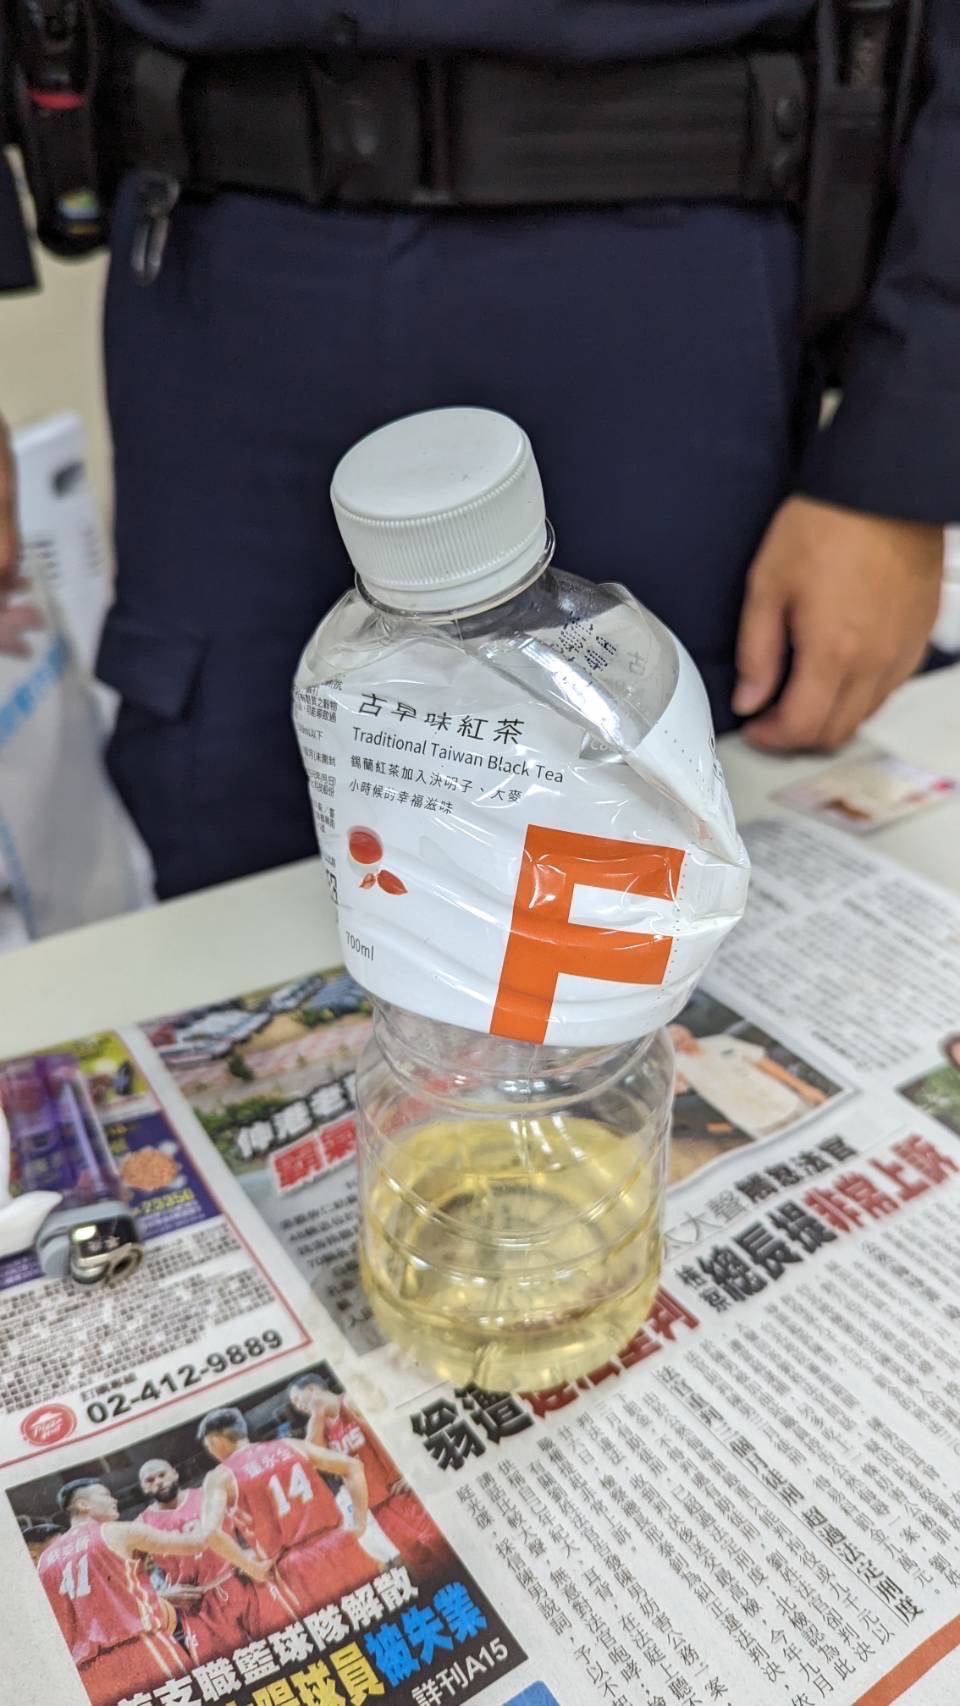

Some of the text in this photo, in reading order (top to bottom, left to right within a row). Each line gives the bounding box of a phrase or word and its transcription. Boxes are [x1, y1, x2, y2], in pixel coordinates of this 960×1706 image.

[359, 693, 524, 744] 古早味紅茶
[352, 726, 564, 783] Traditional Taiwan Black Tea
[349, 778, 454, 815] 小時候的幸福滋味
[345, 931, 375, 961] 700ml
[86, 1329, 283, 1424] 02-412-9889
[268, 1463, 313, 1517] 14
[59, 1553, 92, 1600] 41
